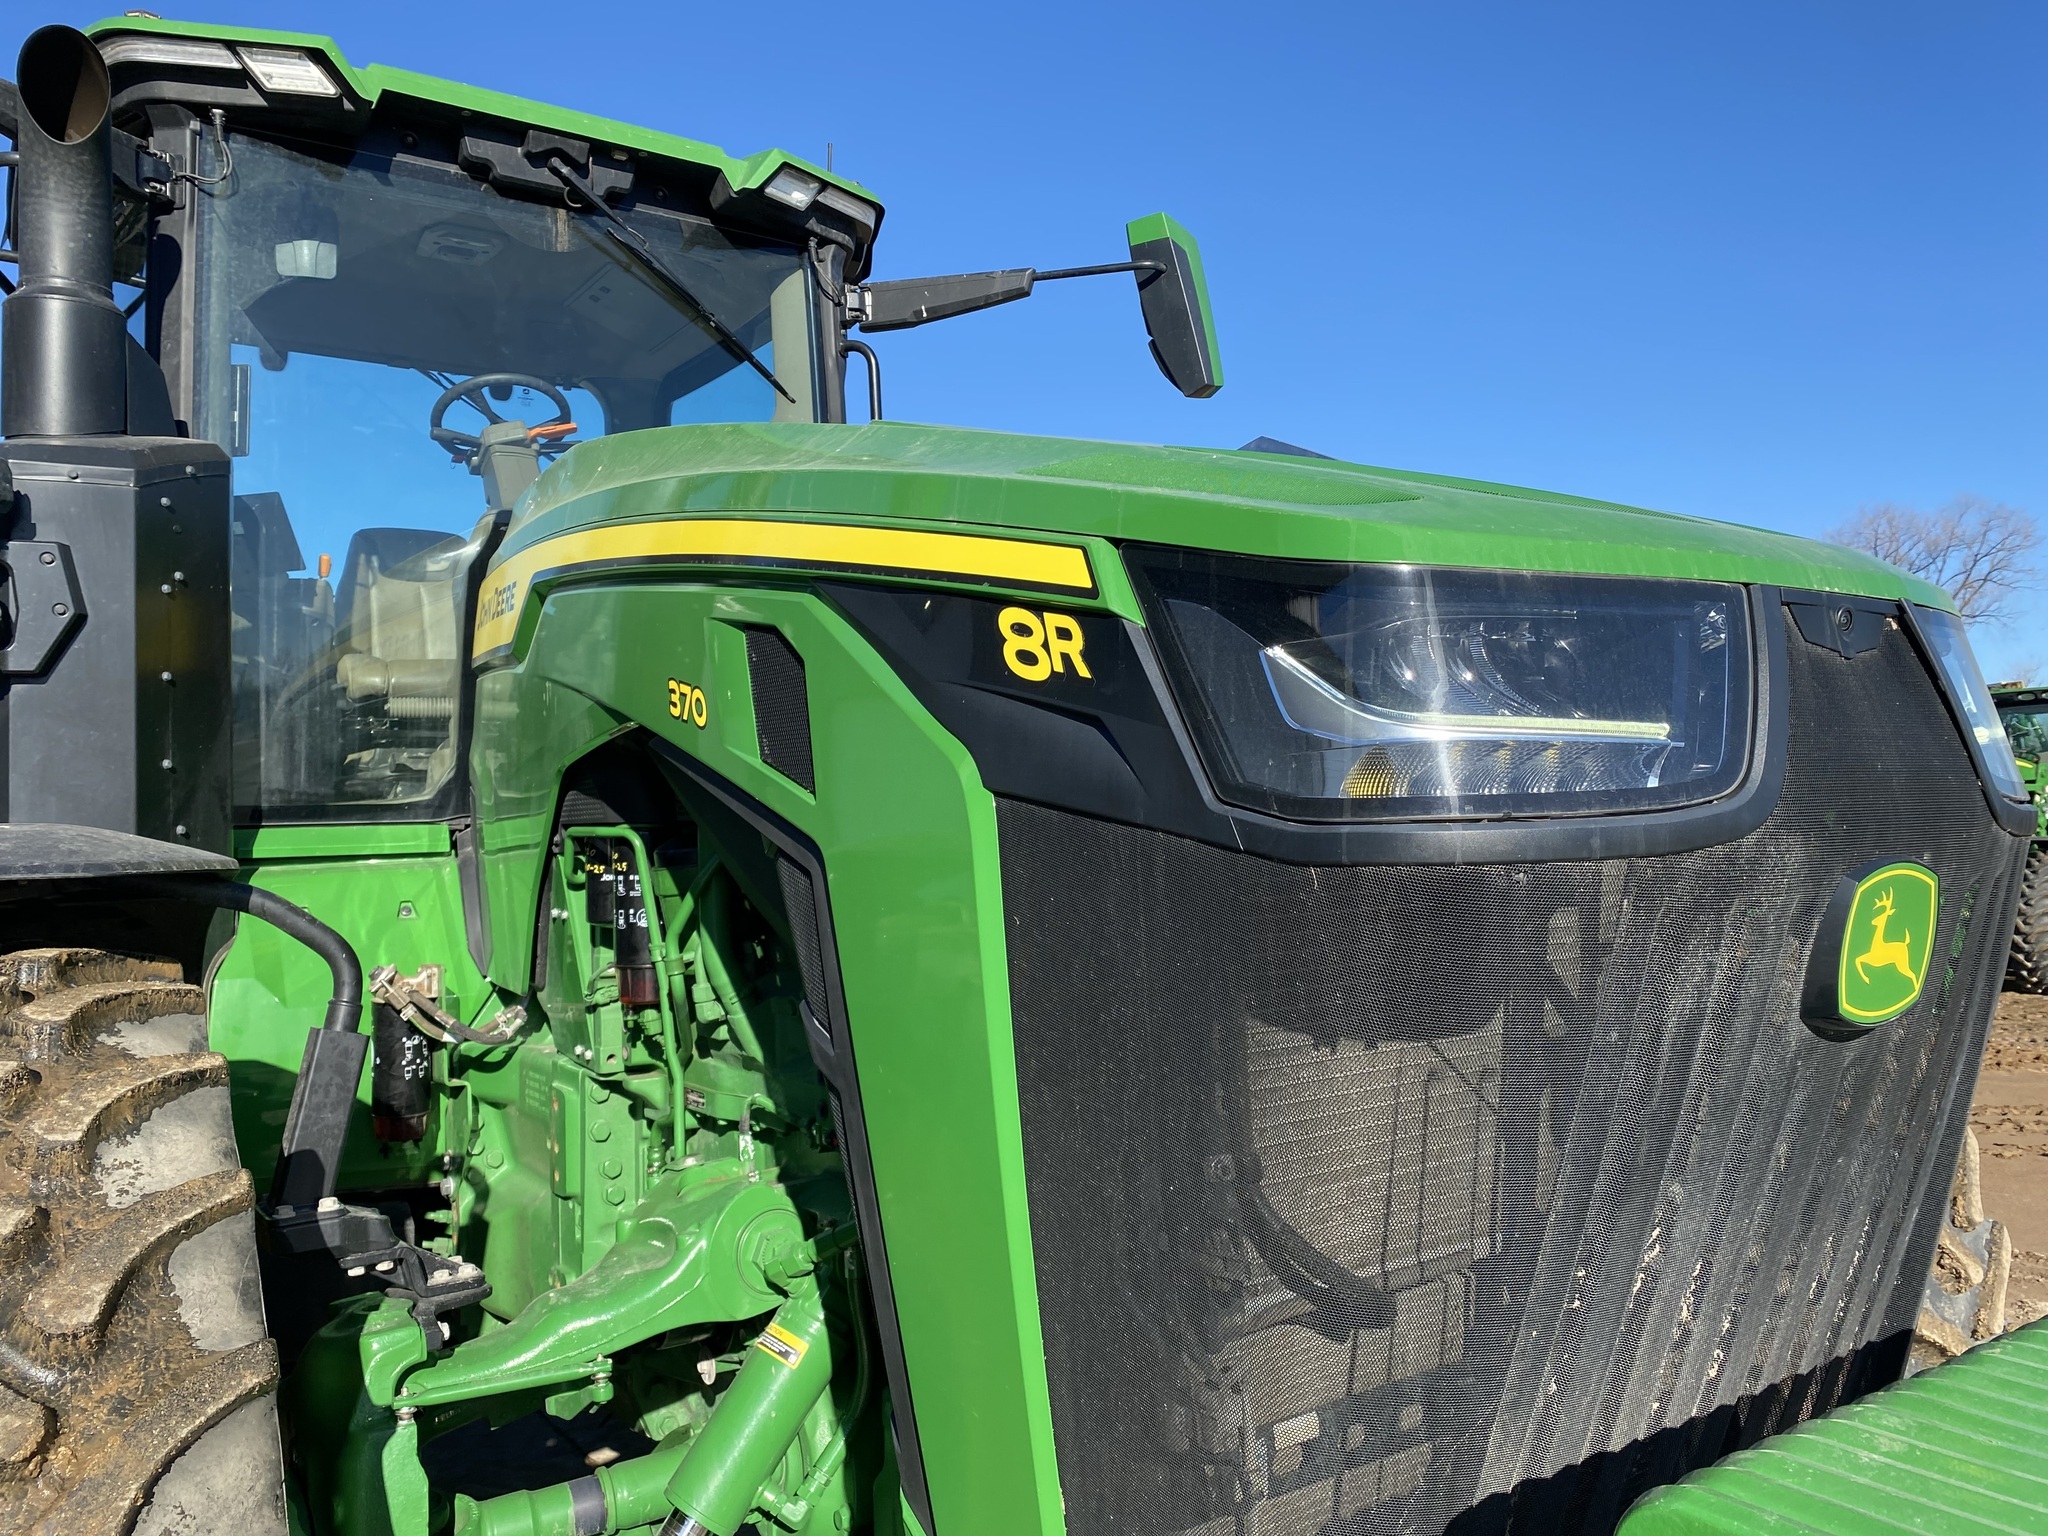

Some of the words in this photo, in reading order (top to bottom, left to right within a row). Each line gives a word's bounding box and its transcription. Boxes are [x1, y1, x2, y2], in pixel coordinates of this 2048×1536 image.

[491, 580, 517, 621] DEERE
[997, 606, 1093, 682] 8R
[667, 677, 708, 731] 370
